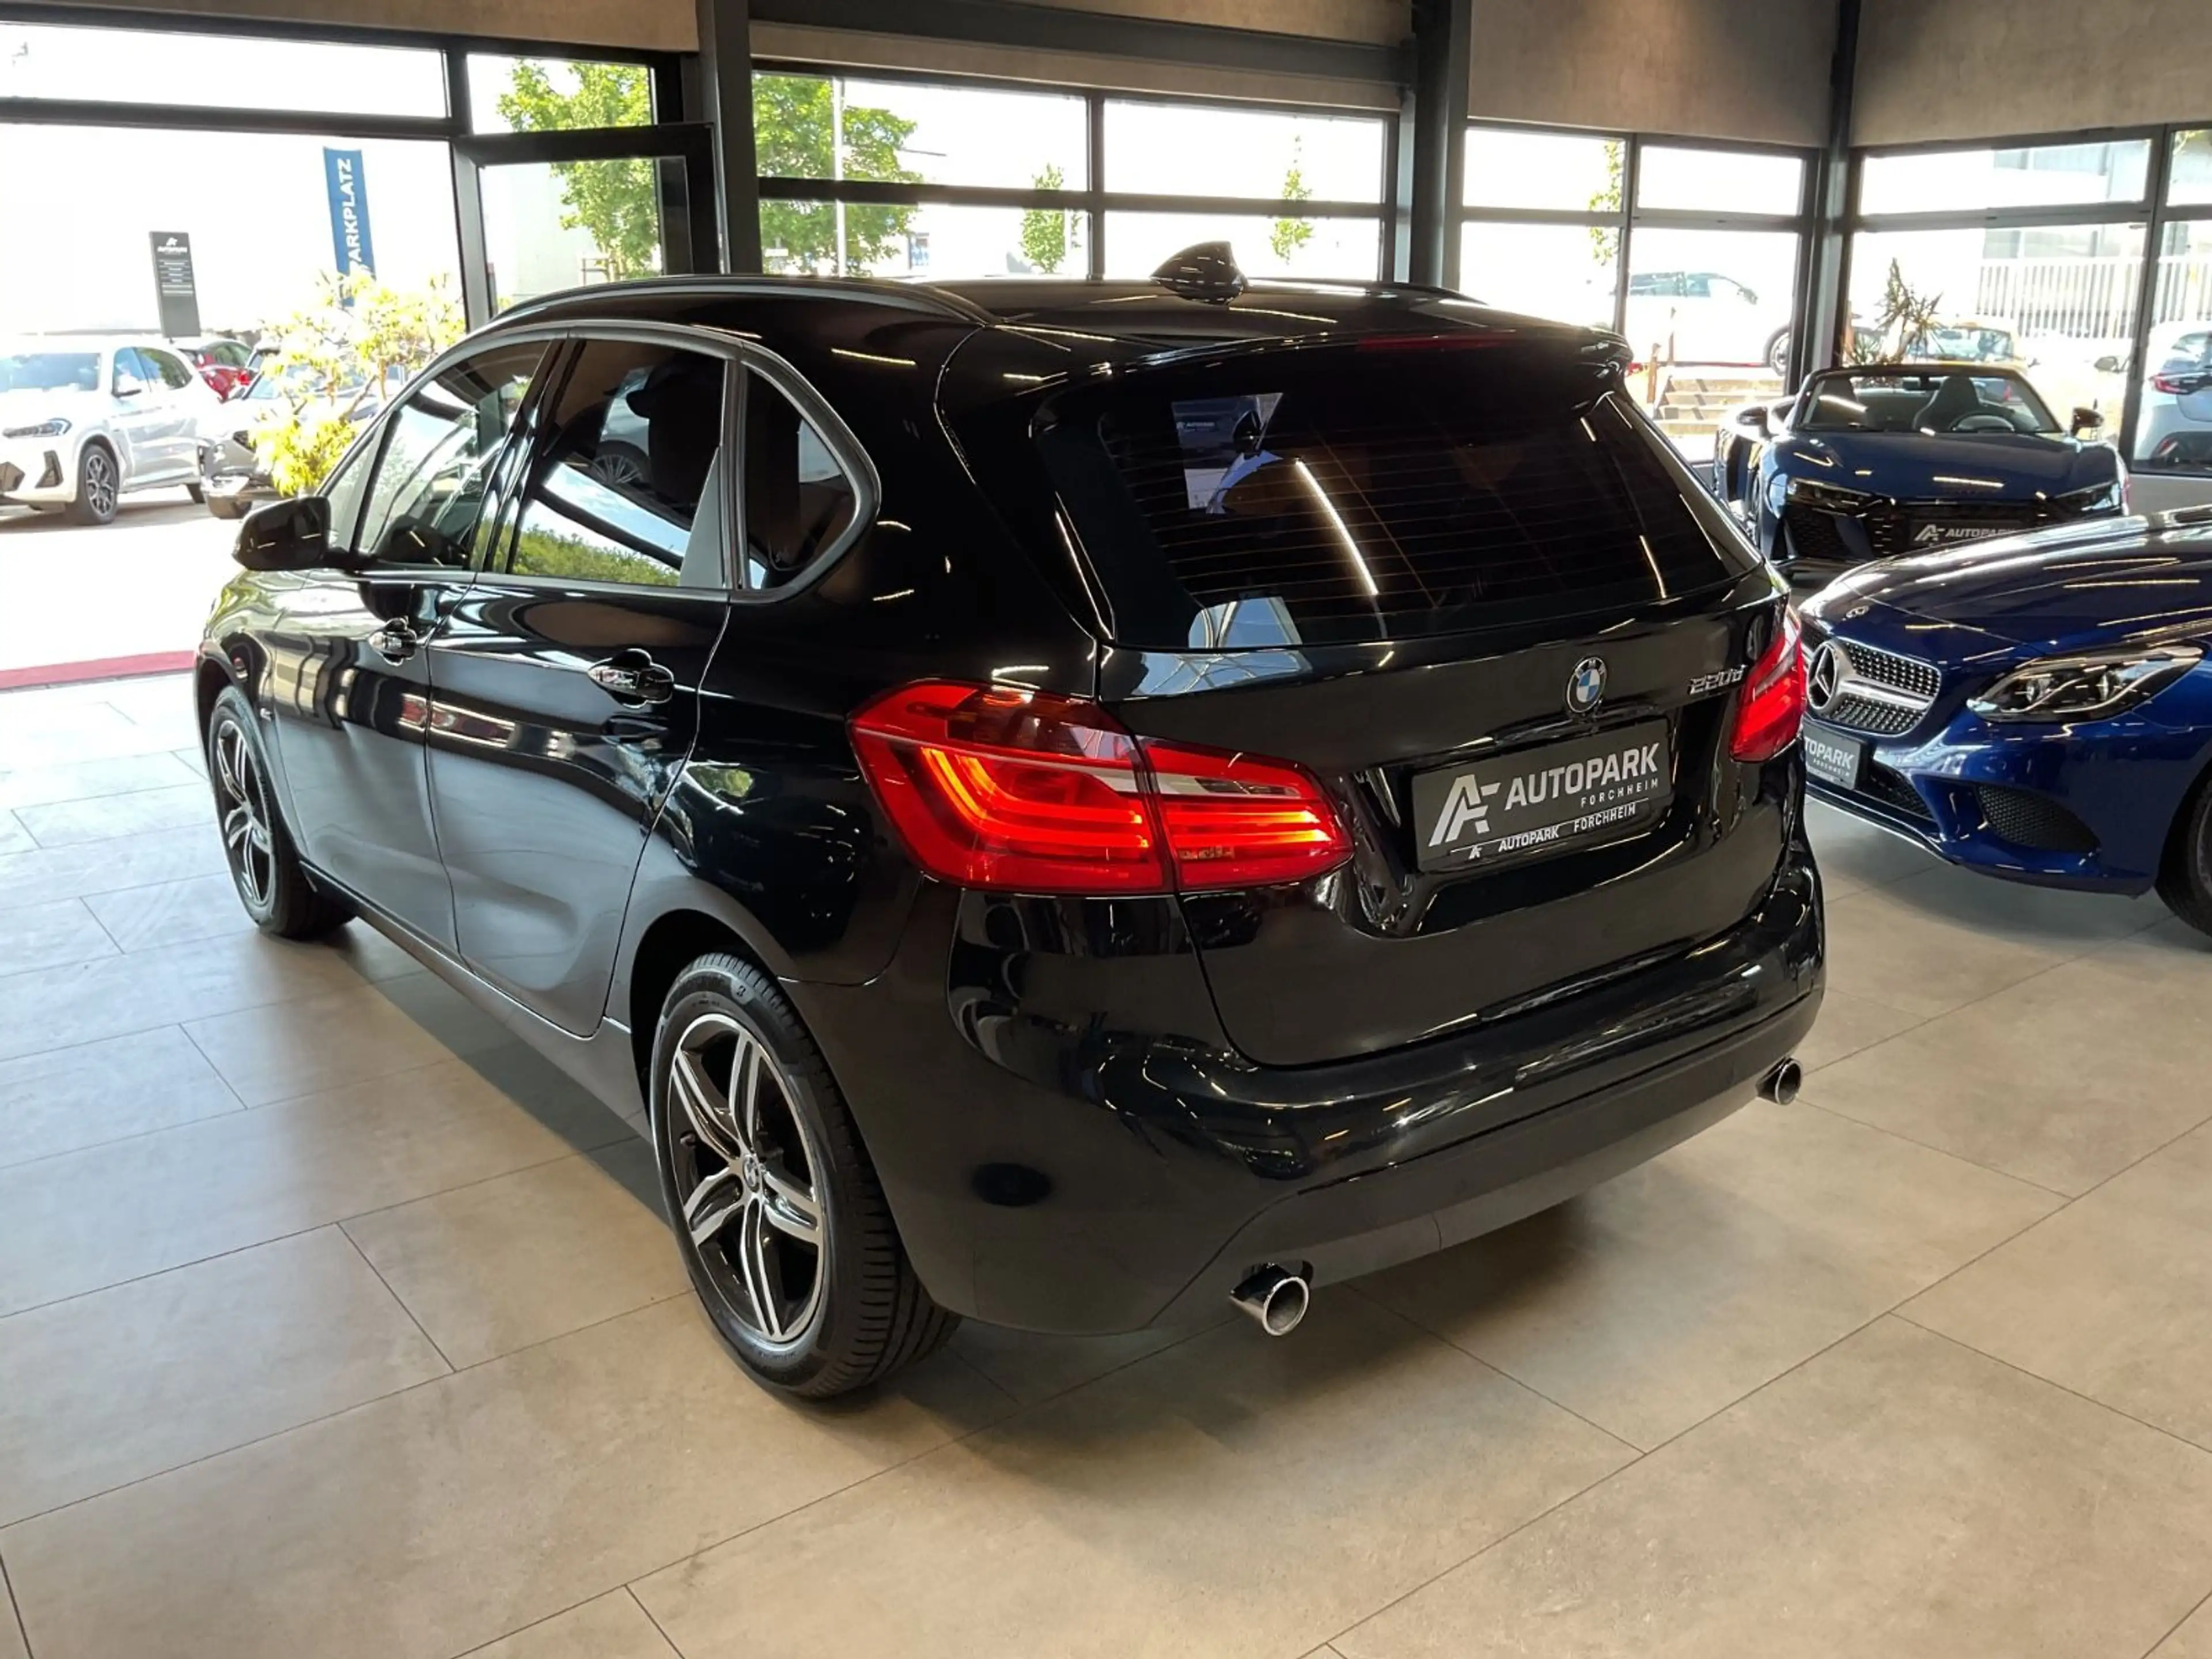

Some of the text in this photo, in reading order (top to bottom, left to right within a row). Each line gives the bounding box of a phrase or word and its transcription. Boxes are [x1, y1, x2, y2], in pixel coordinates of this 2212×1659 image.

[337, 157, 363, 268] ARKPLATZ
[1690, 664, 1747, 695] 220d
[1804, 736, 1855, 770] TOPARK
[1504, 743, 1660, 811] AUTOPARK
[1581, 778, 1658, 808] FORCHHEIM
[1498, 802, 1636, 852] AUTOPARK FORCHHEIM
